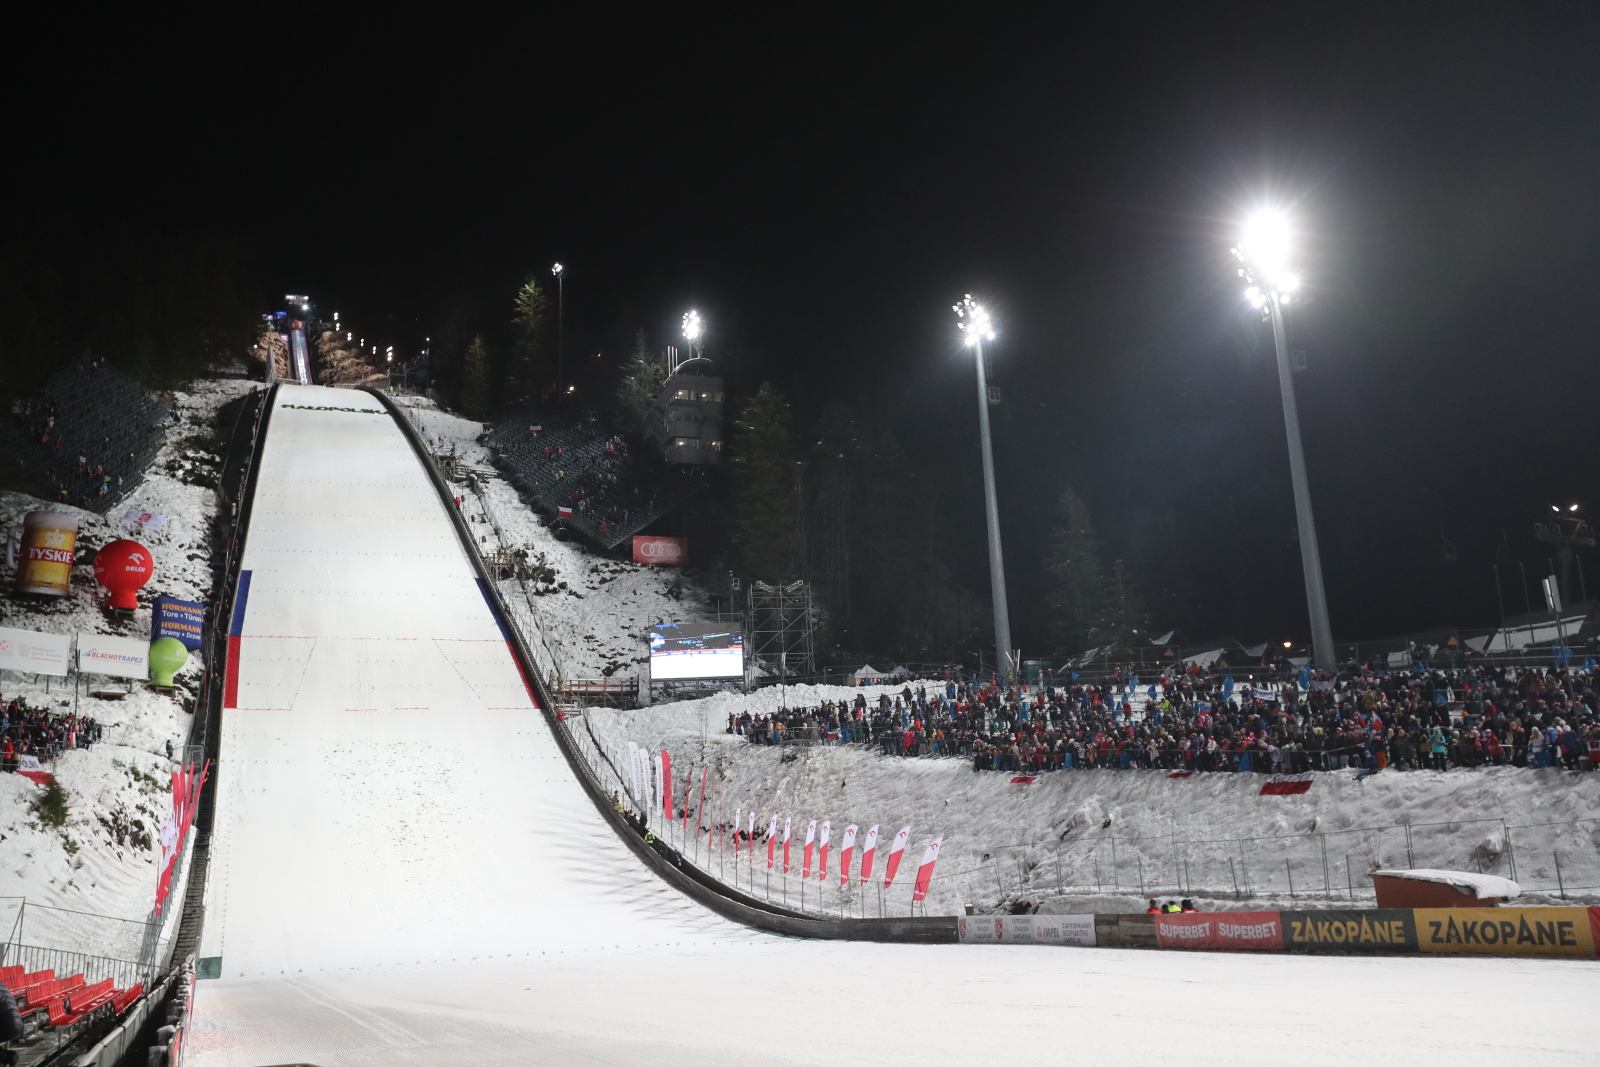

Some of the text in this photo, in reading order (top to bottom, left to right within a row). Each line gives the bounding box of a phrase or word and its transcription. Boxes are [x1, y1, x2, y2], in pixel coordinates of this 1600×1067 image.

[28, 547, 73, 564] TYSKIE
[125, 565, 146, 573] ORLEN
[161, 610, 179, 619] Tore
[160, 628, 180, 638] Bramy
[91, 651, 143, 664] BLACHOTRAPEZ
[1160, 922, 1210, 938] SUPERBET
[1219, 921, 1276, 939] SUPERBET
[1291, 914, 1405, 943] ZAKOPANE
[1429, 914, 1577, 946] ZAKOPANE
